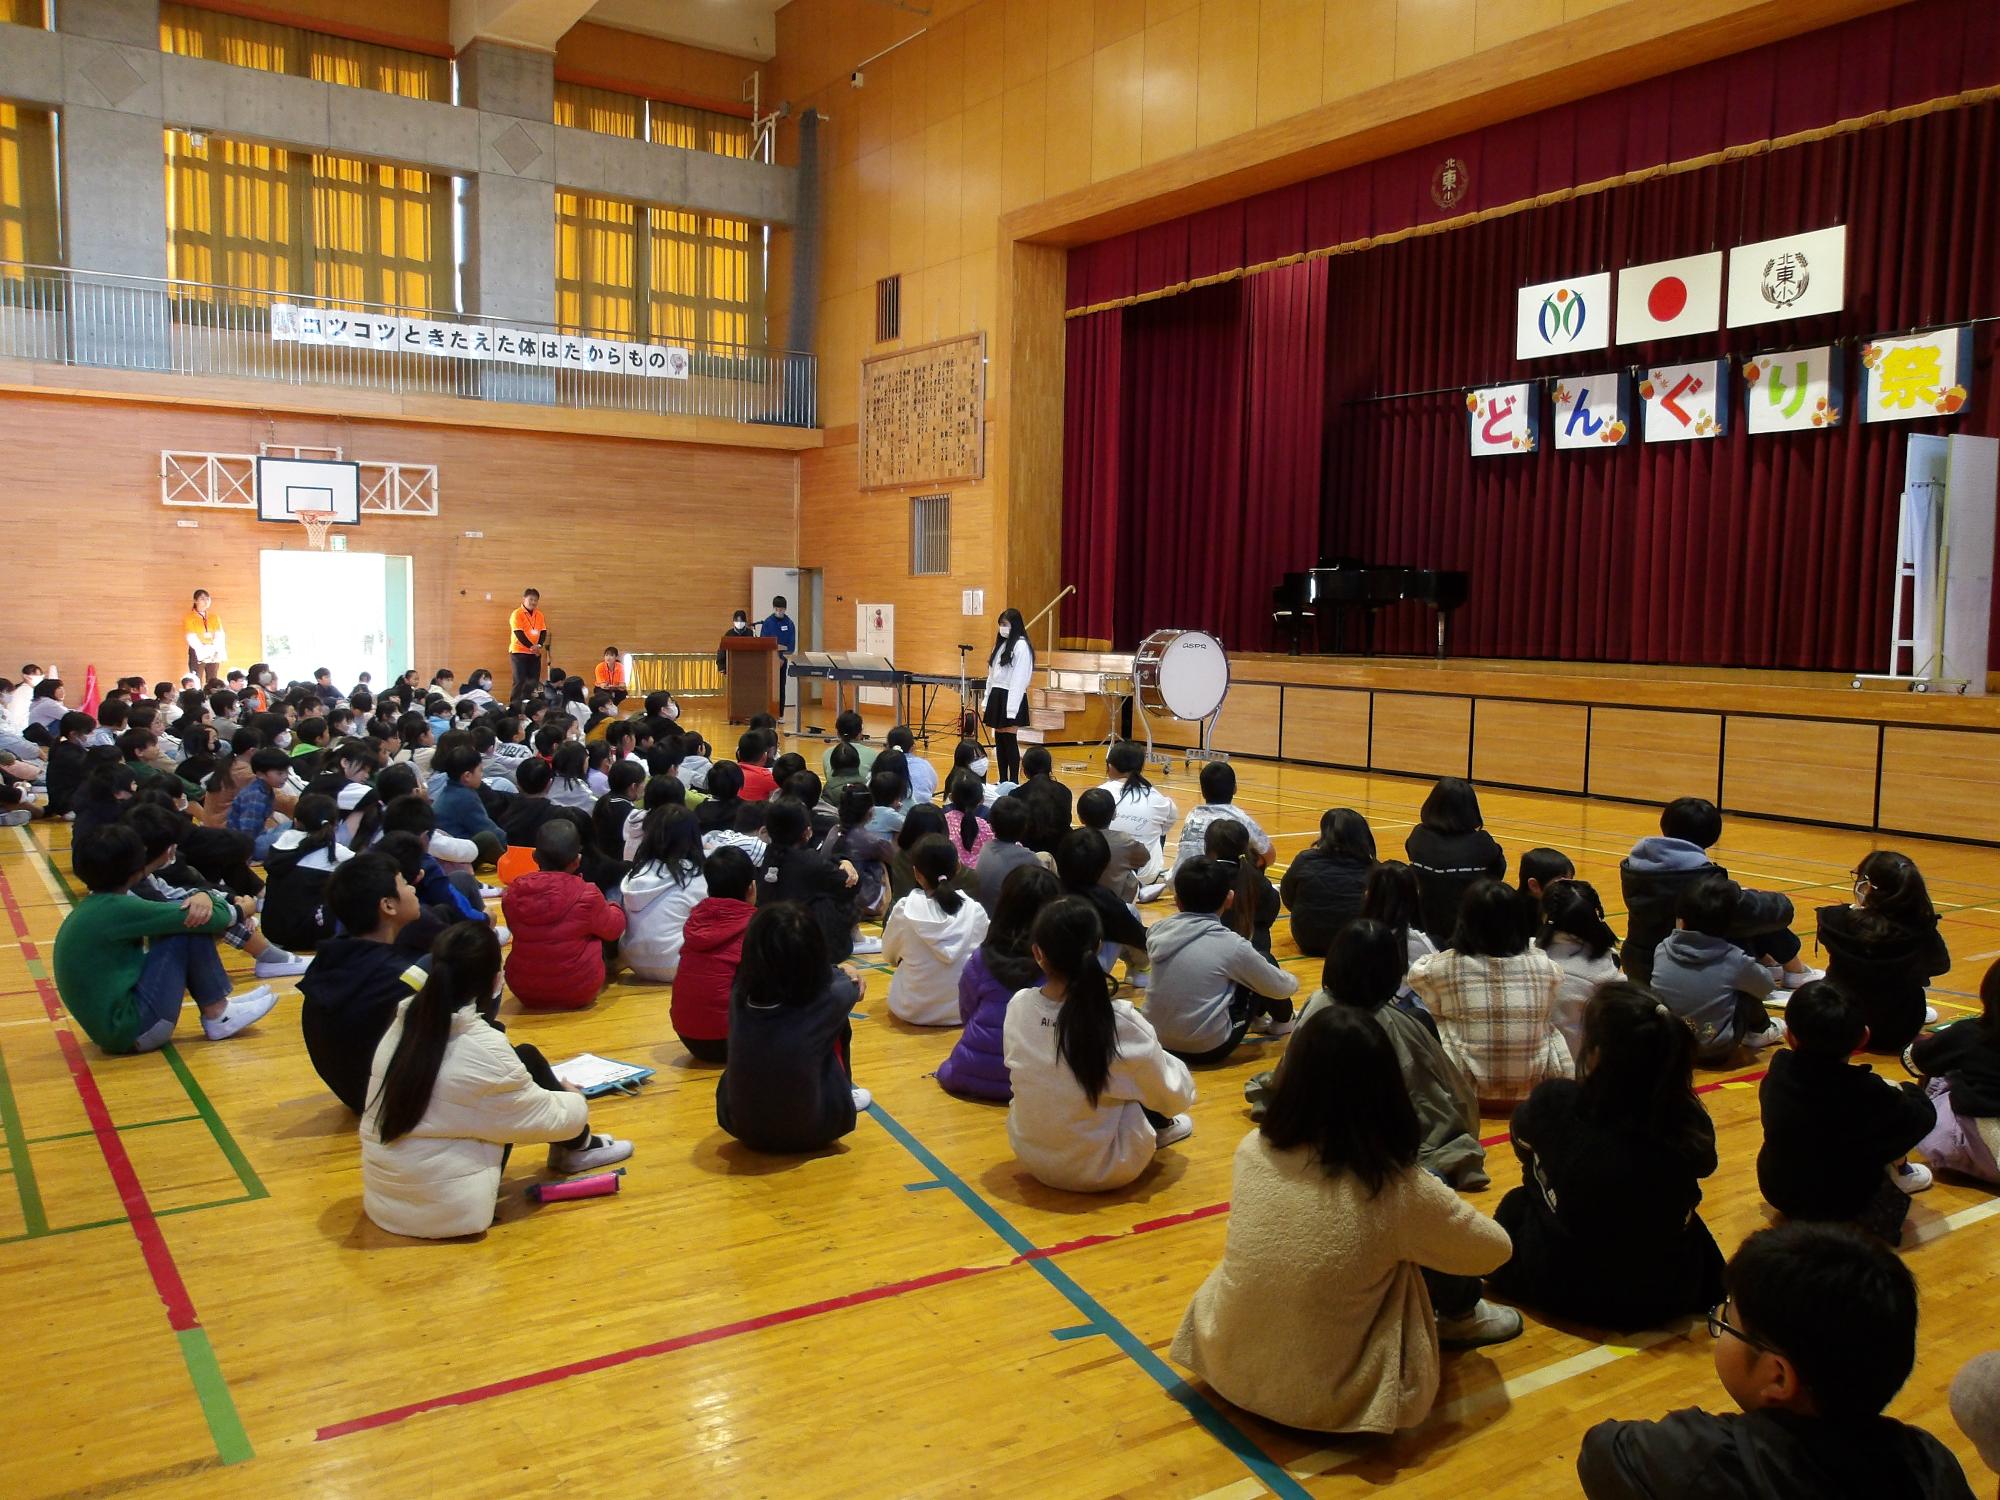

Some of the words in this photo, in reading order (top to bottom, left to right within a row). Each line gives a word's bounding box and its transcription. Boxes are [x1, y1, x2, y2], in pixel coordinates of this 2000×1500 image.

[1774, 252, 1797, 300] 北東小
[302, 315, 667, 370] コツコツときたえた体はたからもの
[1481, 344, 1943, 446] どんぐり祭
